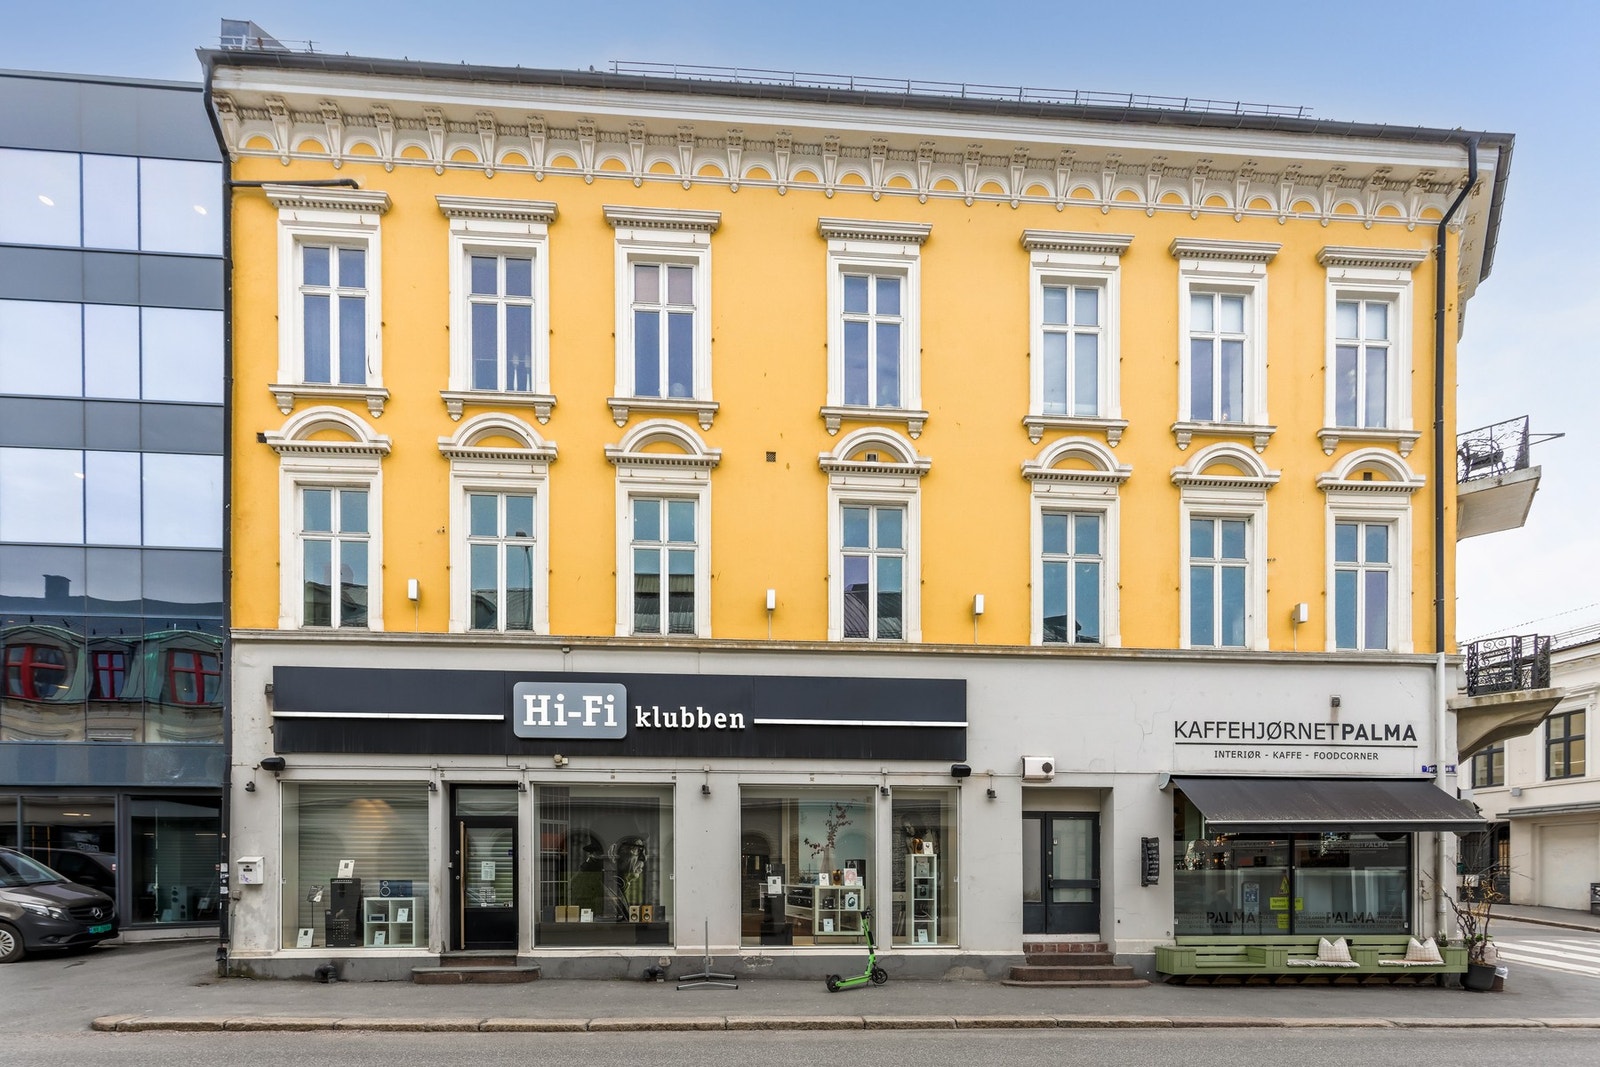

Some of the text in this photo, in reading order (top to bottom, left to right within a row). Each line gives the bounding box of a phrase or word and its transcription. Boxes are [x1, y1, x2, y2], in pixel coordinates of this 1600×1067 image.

[523, 693, 746, 730] Hi-Fi klubben
[1214, 750, 1261, 759] INTERIØR
[1272, 751, 1302, 760] KAFFE
[1313, 752, 1379, 760] FOODCORNER
[1206, 911, 1256, 924] PALMA
[1326, 911, 1375, 924] PALMA
